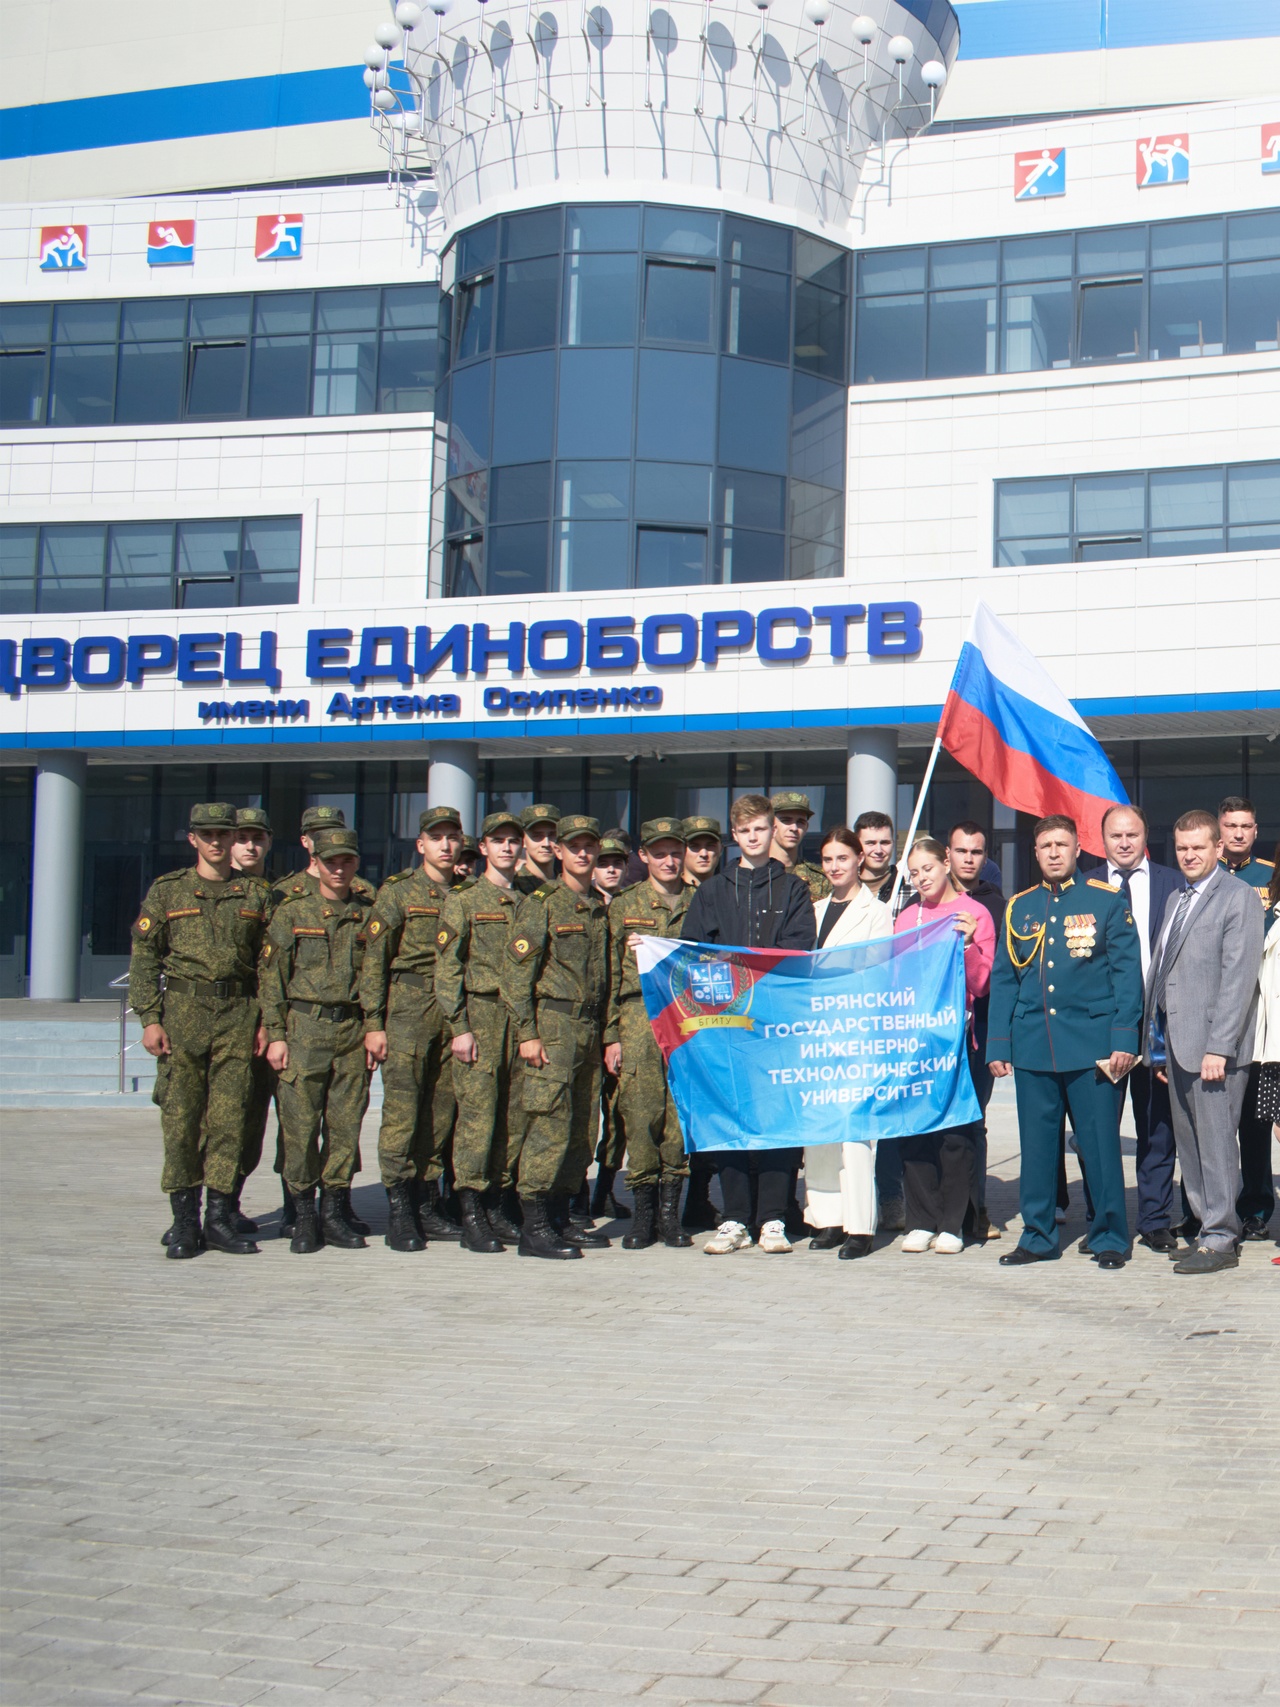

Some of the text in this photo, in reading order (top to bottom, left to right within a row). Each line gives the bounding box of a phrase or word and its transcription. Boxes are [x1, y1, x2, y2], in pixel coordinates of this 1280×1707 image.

[306, 602, 922, 687] ЕДИНОБОРСТВ
[198, 685, 664, 719] имени Артема Осипенко
[810, 986, 916, 1013] БРЯНСКИЙ
[698, 1017, 732, 1027] БГИТУ
[764, 1005, 957, 1039] ГОСУДАРСТВЕННЫЙ
[800, 1037, 927, 1060] ИНЖЕНЕРНО-
[768, 1052, 957, 1085] ТЕХНОЛОГИЧЕСКИЙ
[799, 1080, 934, 1107] УНИВЕРСИТЕТ
